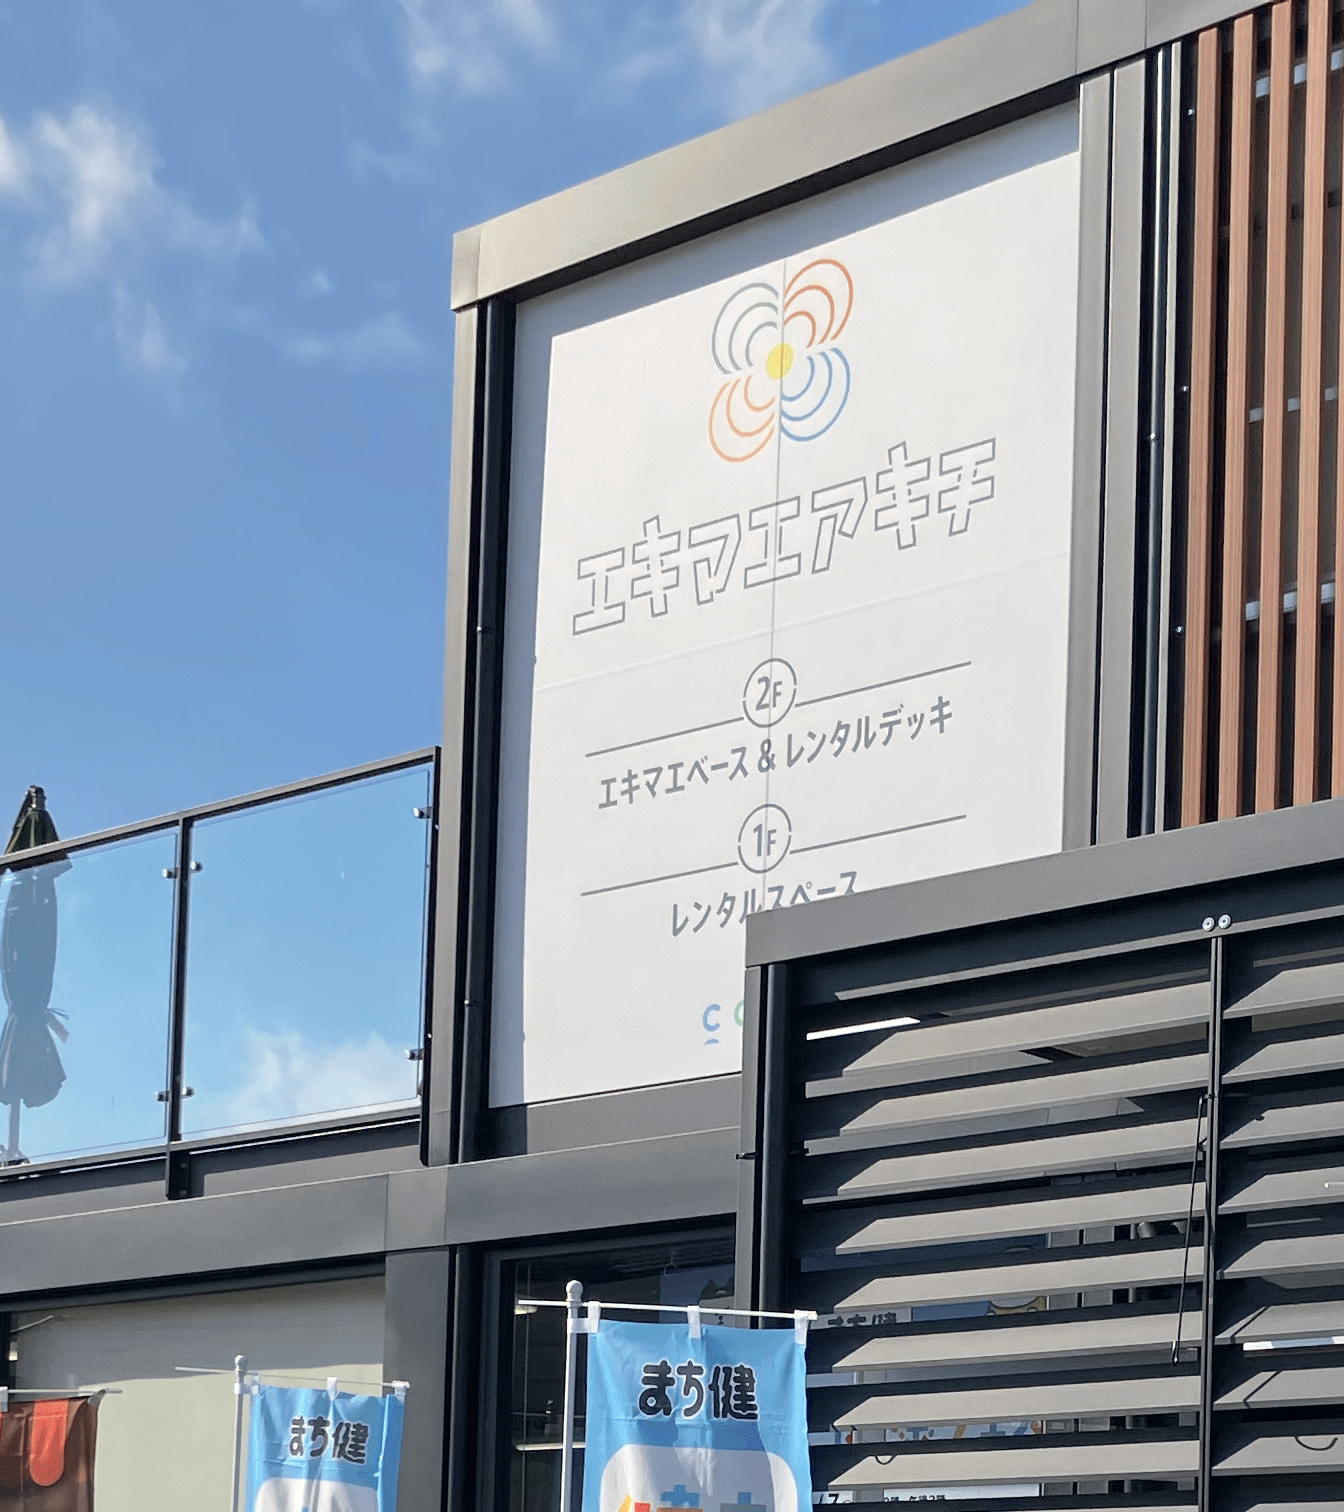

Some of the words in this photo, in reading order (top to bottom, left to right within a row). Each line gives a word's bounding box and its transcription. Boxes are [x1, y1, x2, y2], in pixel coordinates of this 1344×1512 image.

[572, 437, 996, 636] エキマエアキチ
[755, 676, 783, 712] 2F
[598, 746, 749, 810] エキマエベース
[786, 695, 953, 769] レンタルデッキ
[752, 823, 777, 858] 1F
[638, 1359, 760, 1421] まち健
[288, 1414, 370, 1465] まち健
